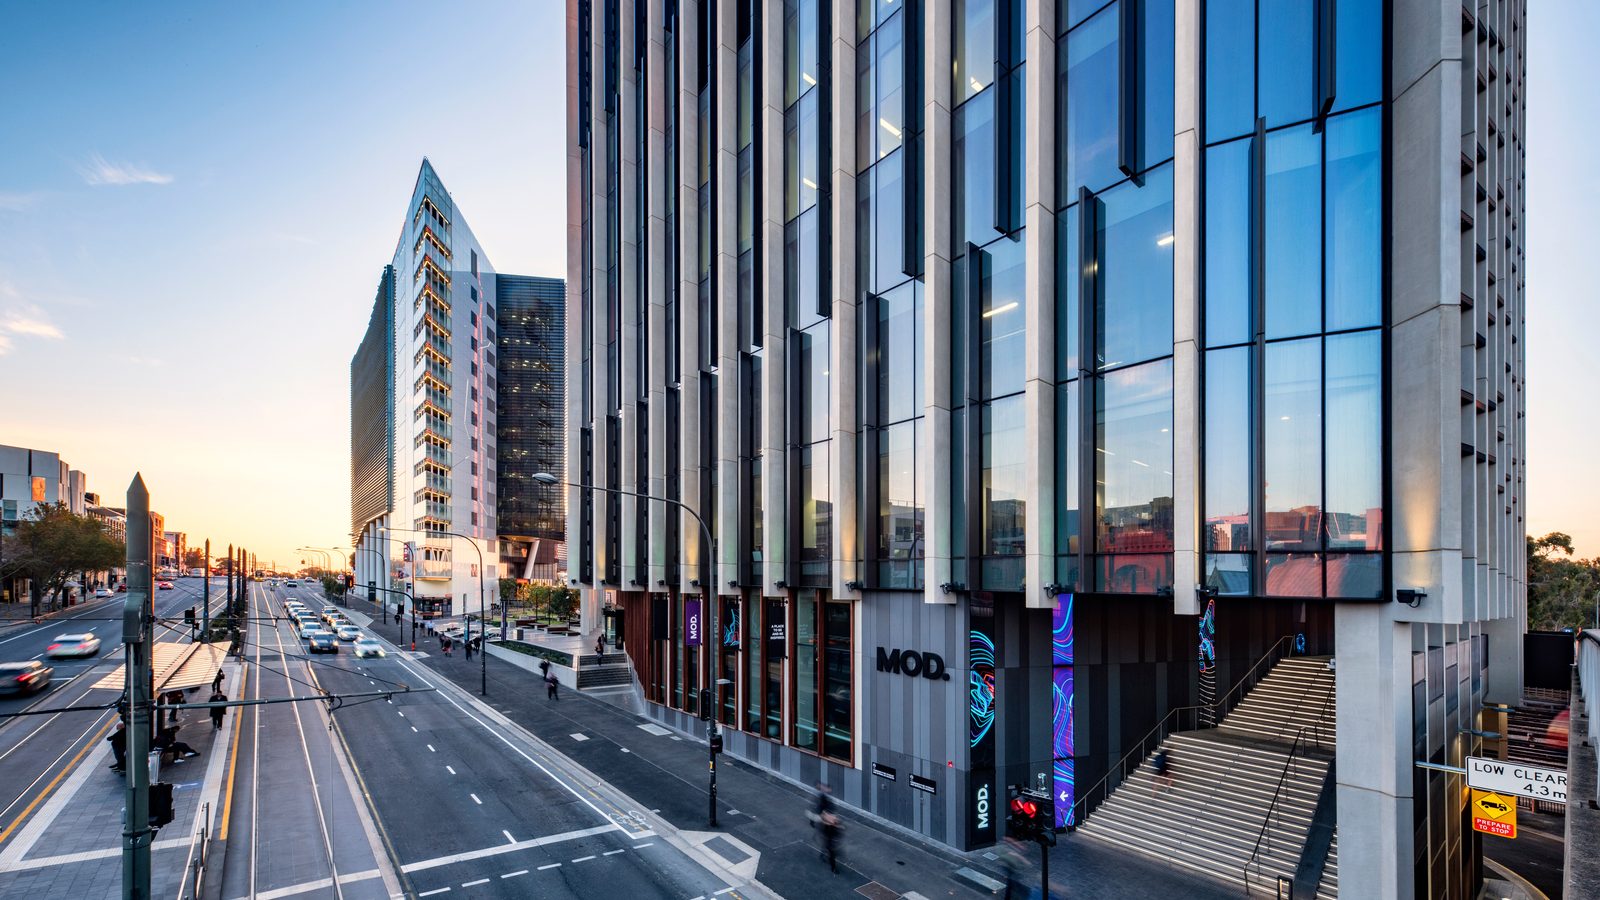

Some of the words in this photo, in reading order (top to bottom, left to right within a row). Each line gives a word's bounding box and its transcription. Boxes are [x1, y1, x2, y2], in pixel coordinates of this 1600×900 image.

[877, 647, 950, 681] MOD.
[1474, 762, 1504, 775] LOW
[978, 784, 988, 829] MOD.
[1476, 818, 1511, 830] PREPARE
[1491, 825, 1510, 835] STOP
